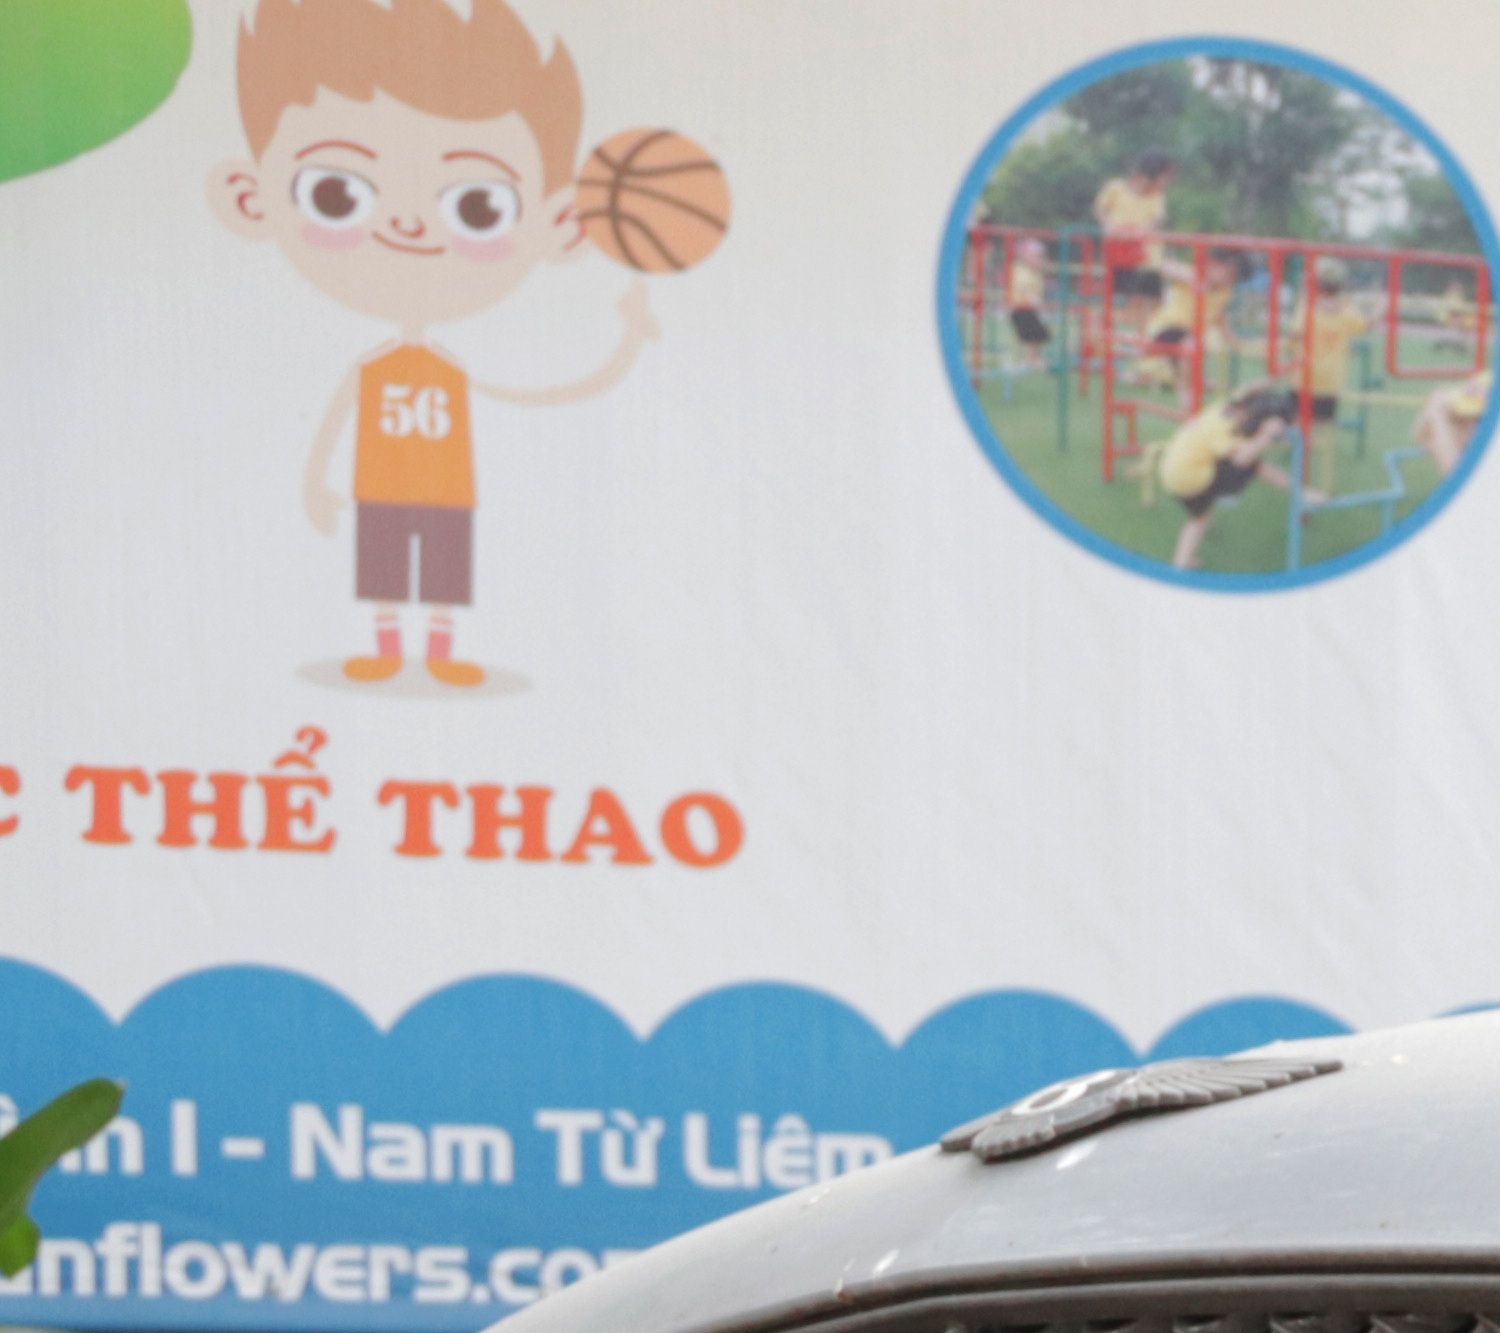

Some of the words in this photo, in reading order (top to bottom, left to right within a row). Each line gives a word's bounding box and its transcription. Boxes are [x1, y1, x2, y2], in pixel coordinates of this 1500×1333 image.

[380, 384, 452, 440] 56
[64, 724, 337, 854] THỂ
[377, 779, 744, 870] THAO
[220, 1136, 266, 1159] -
[290, 1101, 514, 1184] Nam
[534, 1108, 665, 1188] Từ
[682, 1111, 895, 1190] Liêm
[0, 1220, 650, 1303] nflowers.co
